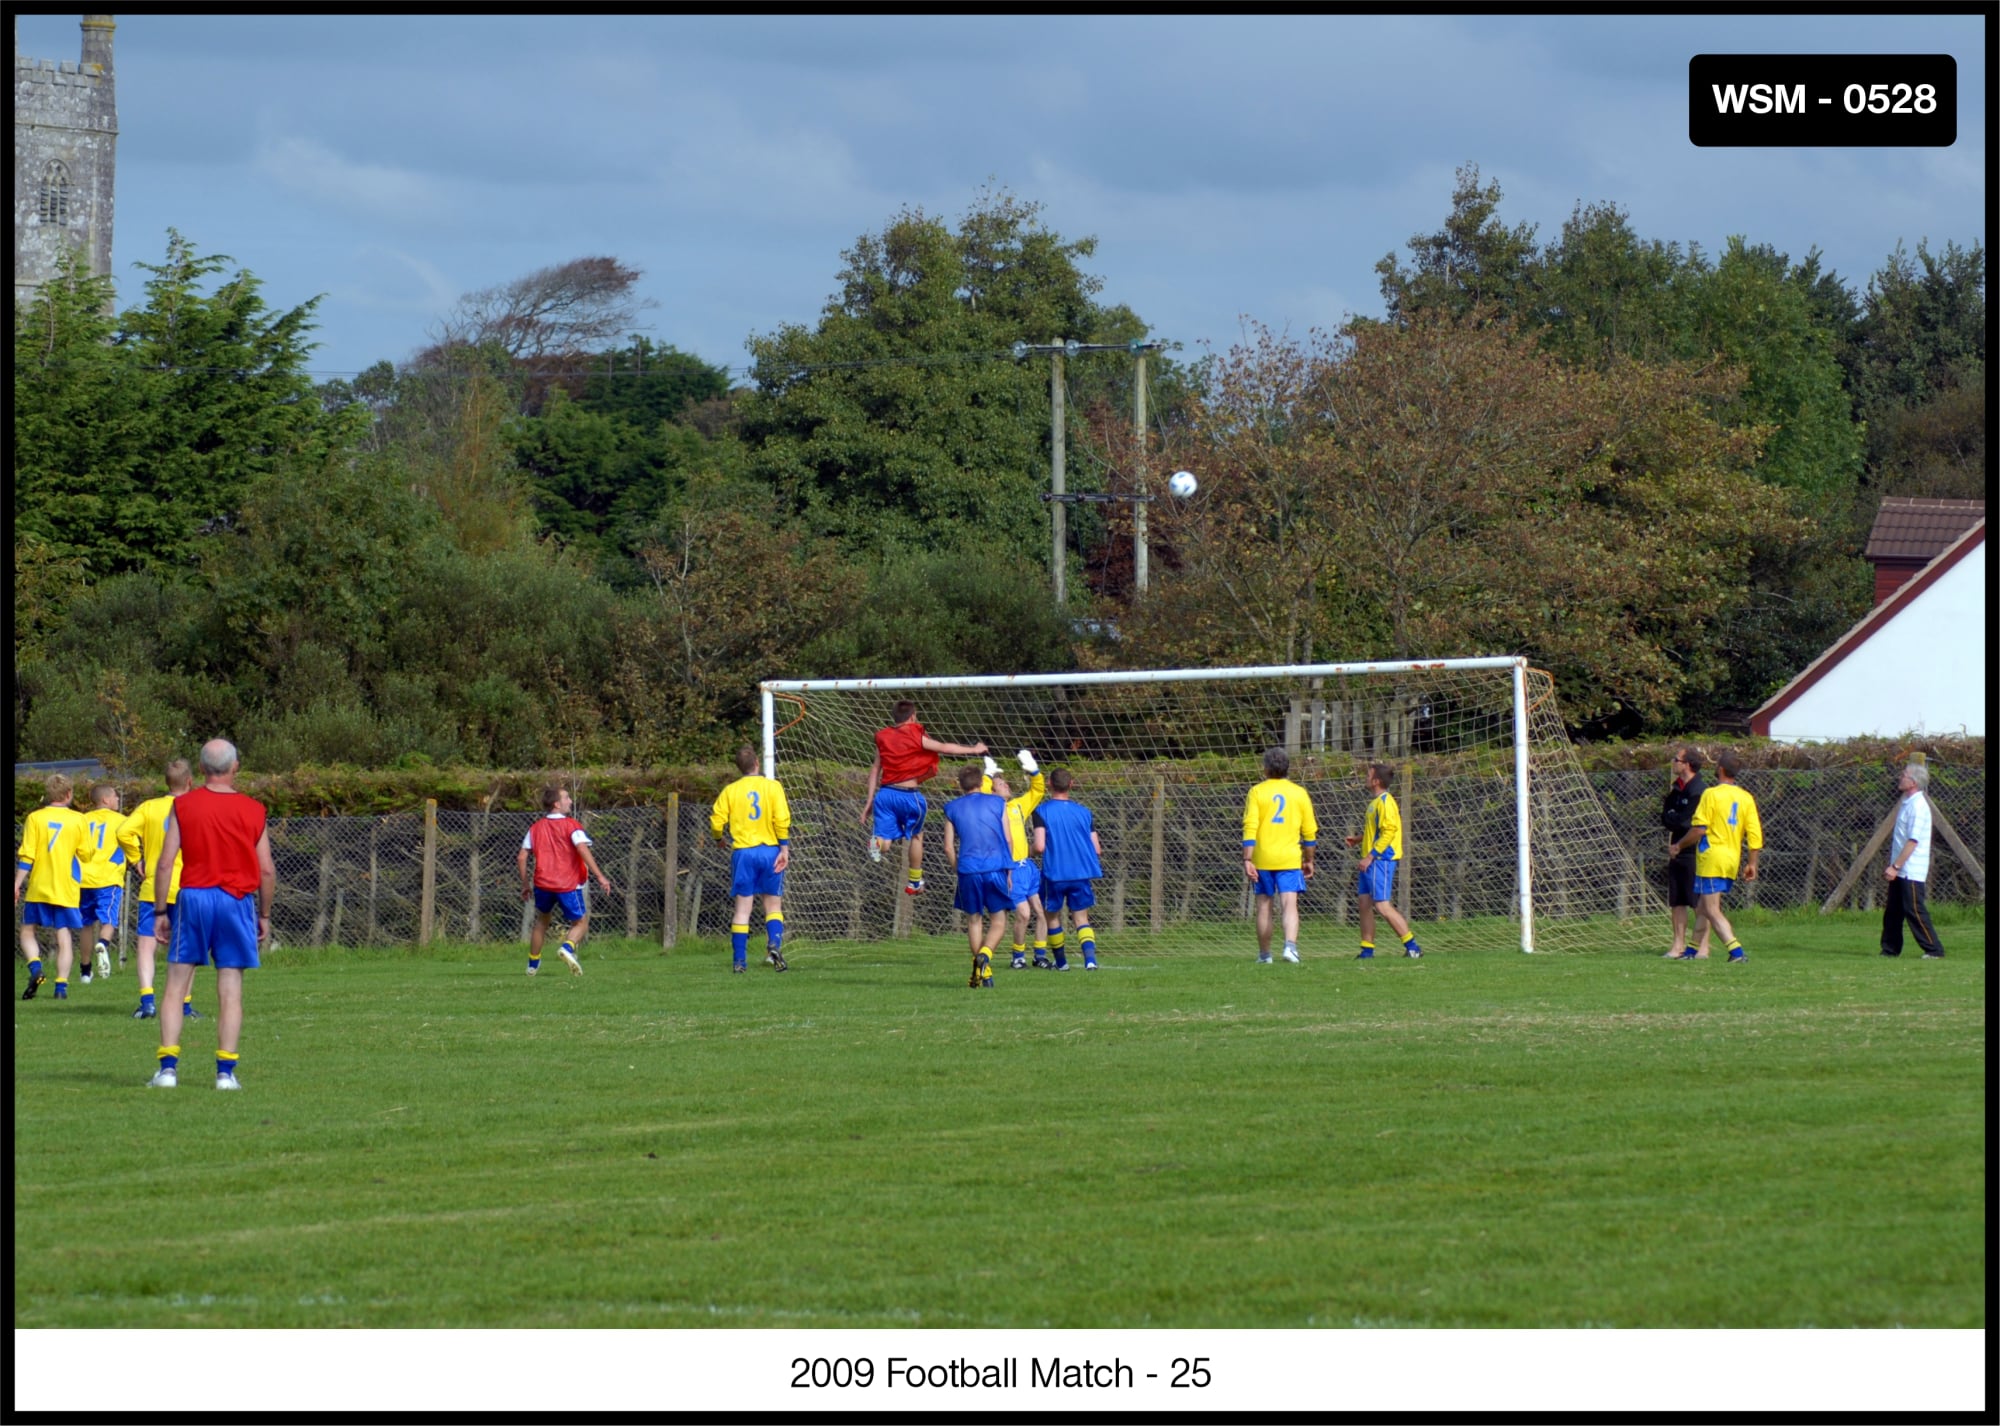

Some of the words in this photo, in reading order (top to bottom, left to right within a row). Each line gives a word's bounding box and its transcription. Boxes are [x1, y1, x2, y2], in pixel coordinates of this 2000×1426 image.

[747, 791, 762, 820] 3
[1271, 794, 1286, 824] 2
[1727, 801, 1739, 831] 4
[47, 821, 63, 852] 7
